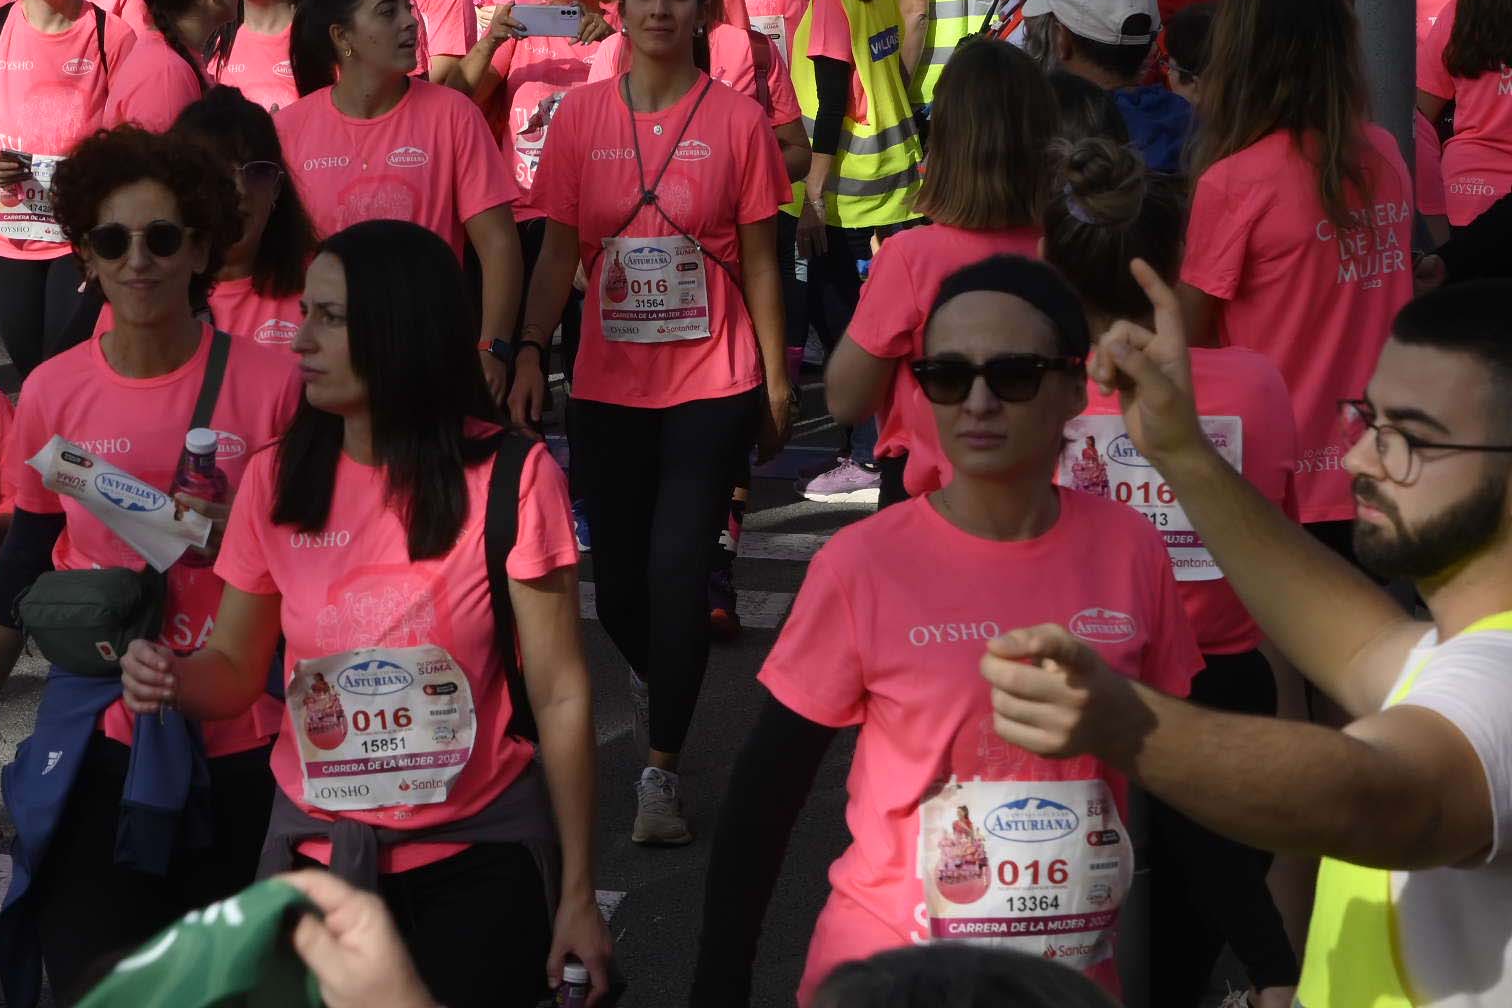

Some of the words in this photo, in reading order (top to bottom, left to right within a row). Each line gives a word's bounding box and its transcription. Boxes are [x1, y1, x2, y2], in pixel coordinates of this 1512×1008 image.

[303, 156, 350, 171] OYSHO
[591, 148, 635, 161] OYSHO
[1337, 250, 1406, 285] MUJER
[630, 279, 669, 294] 016
[635, 298, 665, 309] 31564
[100, 475, 161, 506] ASTURIANA
[1115, 481, 1177, 505] 016
[289, 530, 350, 549] OYSHO
[908, 621, 1001, 648] OYSHO
[418, 663, 452, 676] SUMA
[343, 673, 409, 690] ASTURIANA
[352, 706, 413, 732] 016
[361, 736, 407, 754] 15851
[322, 762, 366, 775] CARRERA
[367, 761, 381, 771] DE
[383, 758, 397, 770] LA
[398, 756, 434, 768] MUJER
[320, 784, 370, 799] OYSHO
[991, 814, 1073, 832] ASTURIANA
[997, 858, 1070, 886] 016
[1006, 894, 1060, 913] 13364
[948, 922, 1008, 934] CARRERA
[1011, 921, 1027, 932] DE
[1029, 920, 1045, 932] LA
[1047, 918, 1086, 931] MUJER
